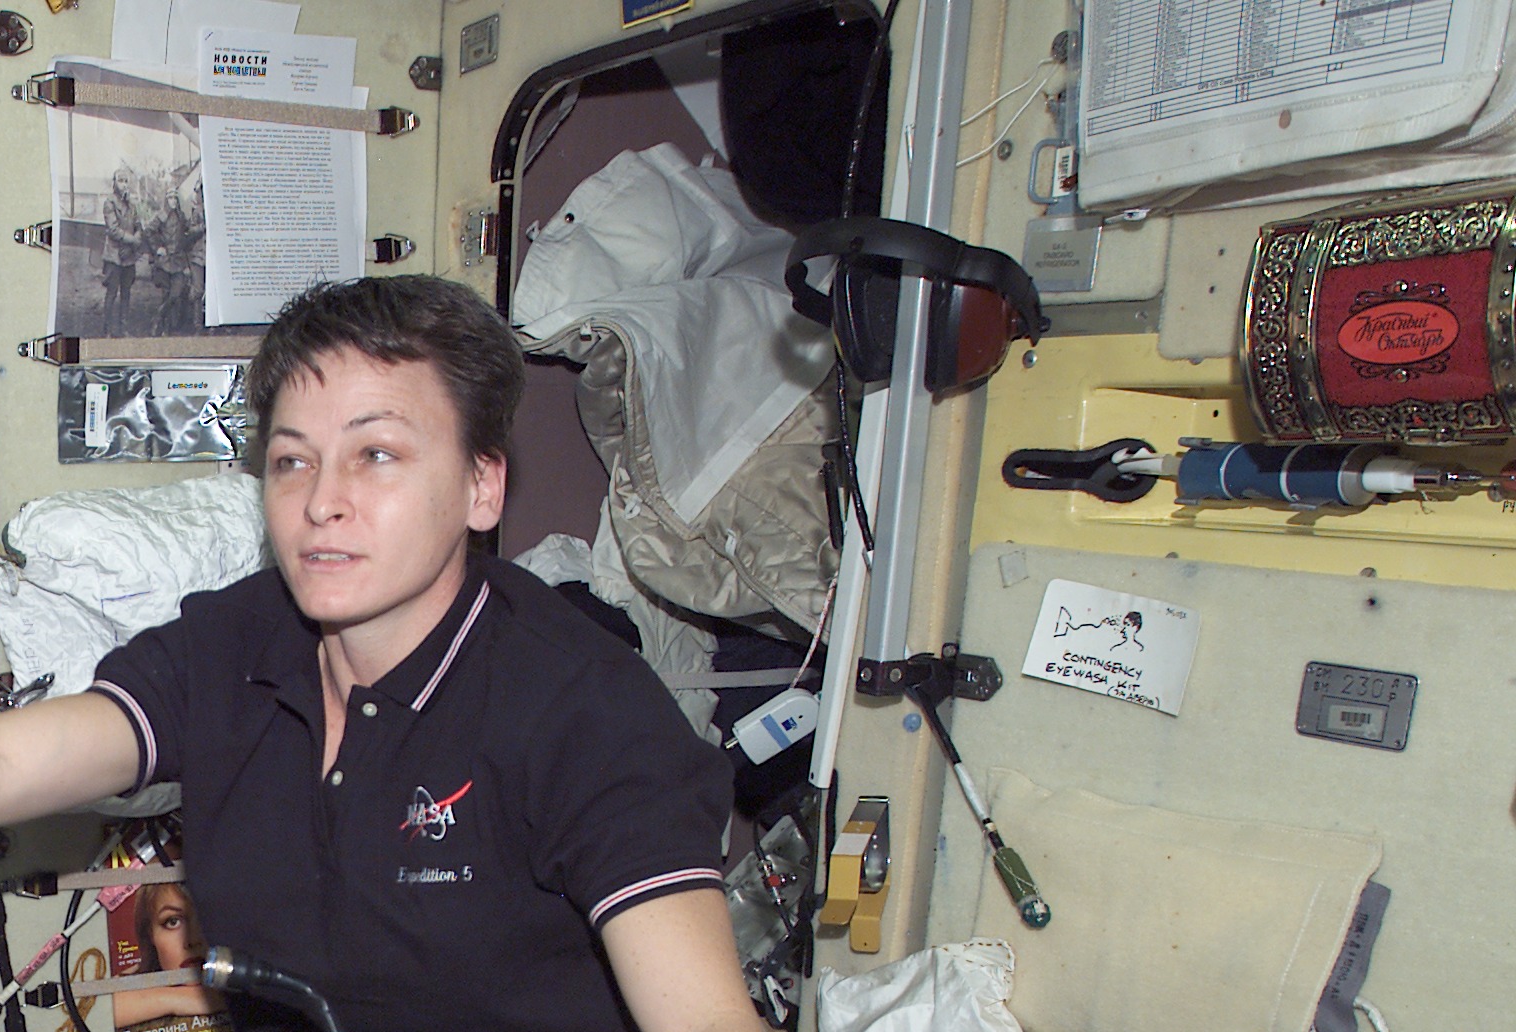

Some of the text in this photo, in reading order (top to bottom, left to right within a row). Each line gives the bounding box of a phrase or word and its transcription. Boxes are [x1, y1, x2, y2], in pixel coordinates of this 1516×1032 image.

[214, 54, 268, 65] НОВОСТИ
[167, 381, 209, 390] Lemonade
[1046, 662, 1141, 692] EYEWASH KIT
[1063, 652, 1143, 680] CONTINGENCY
[1341, 674, 1384, 698] 230
[407, 803, 456, 825] NASA
[463, 865, 473, 881] 5
